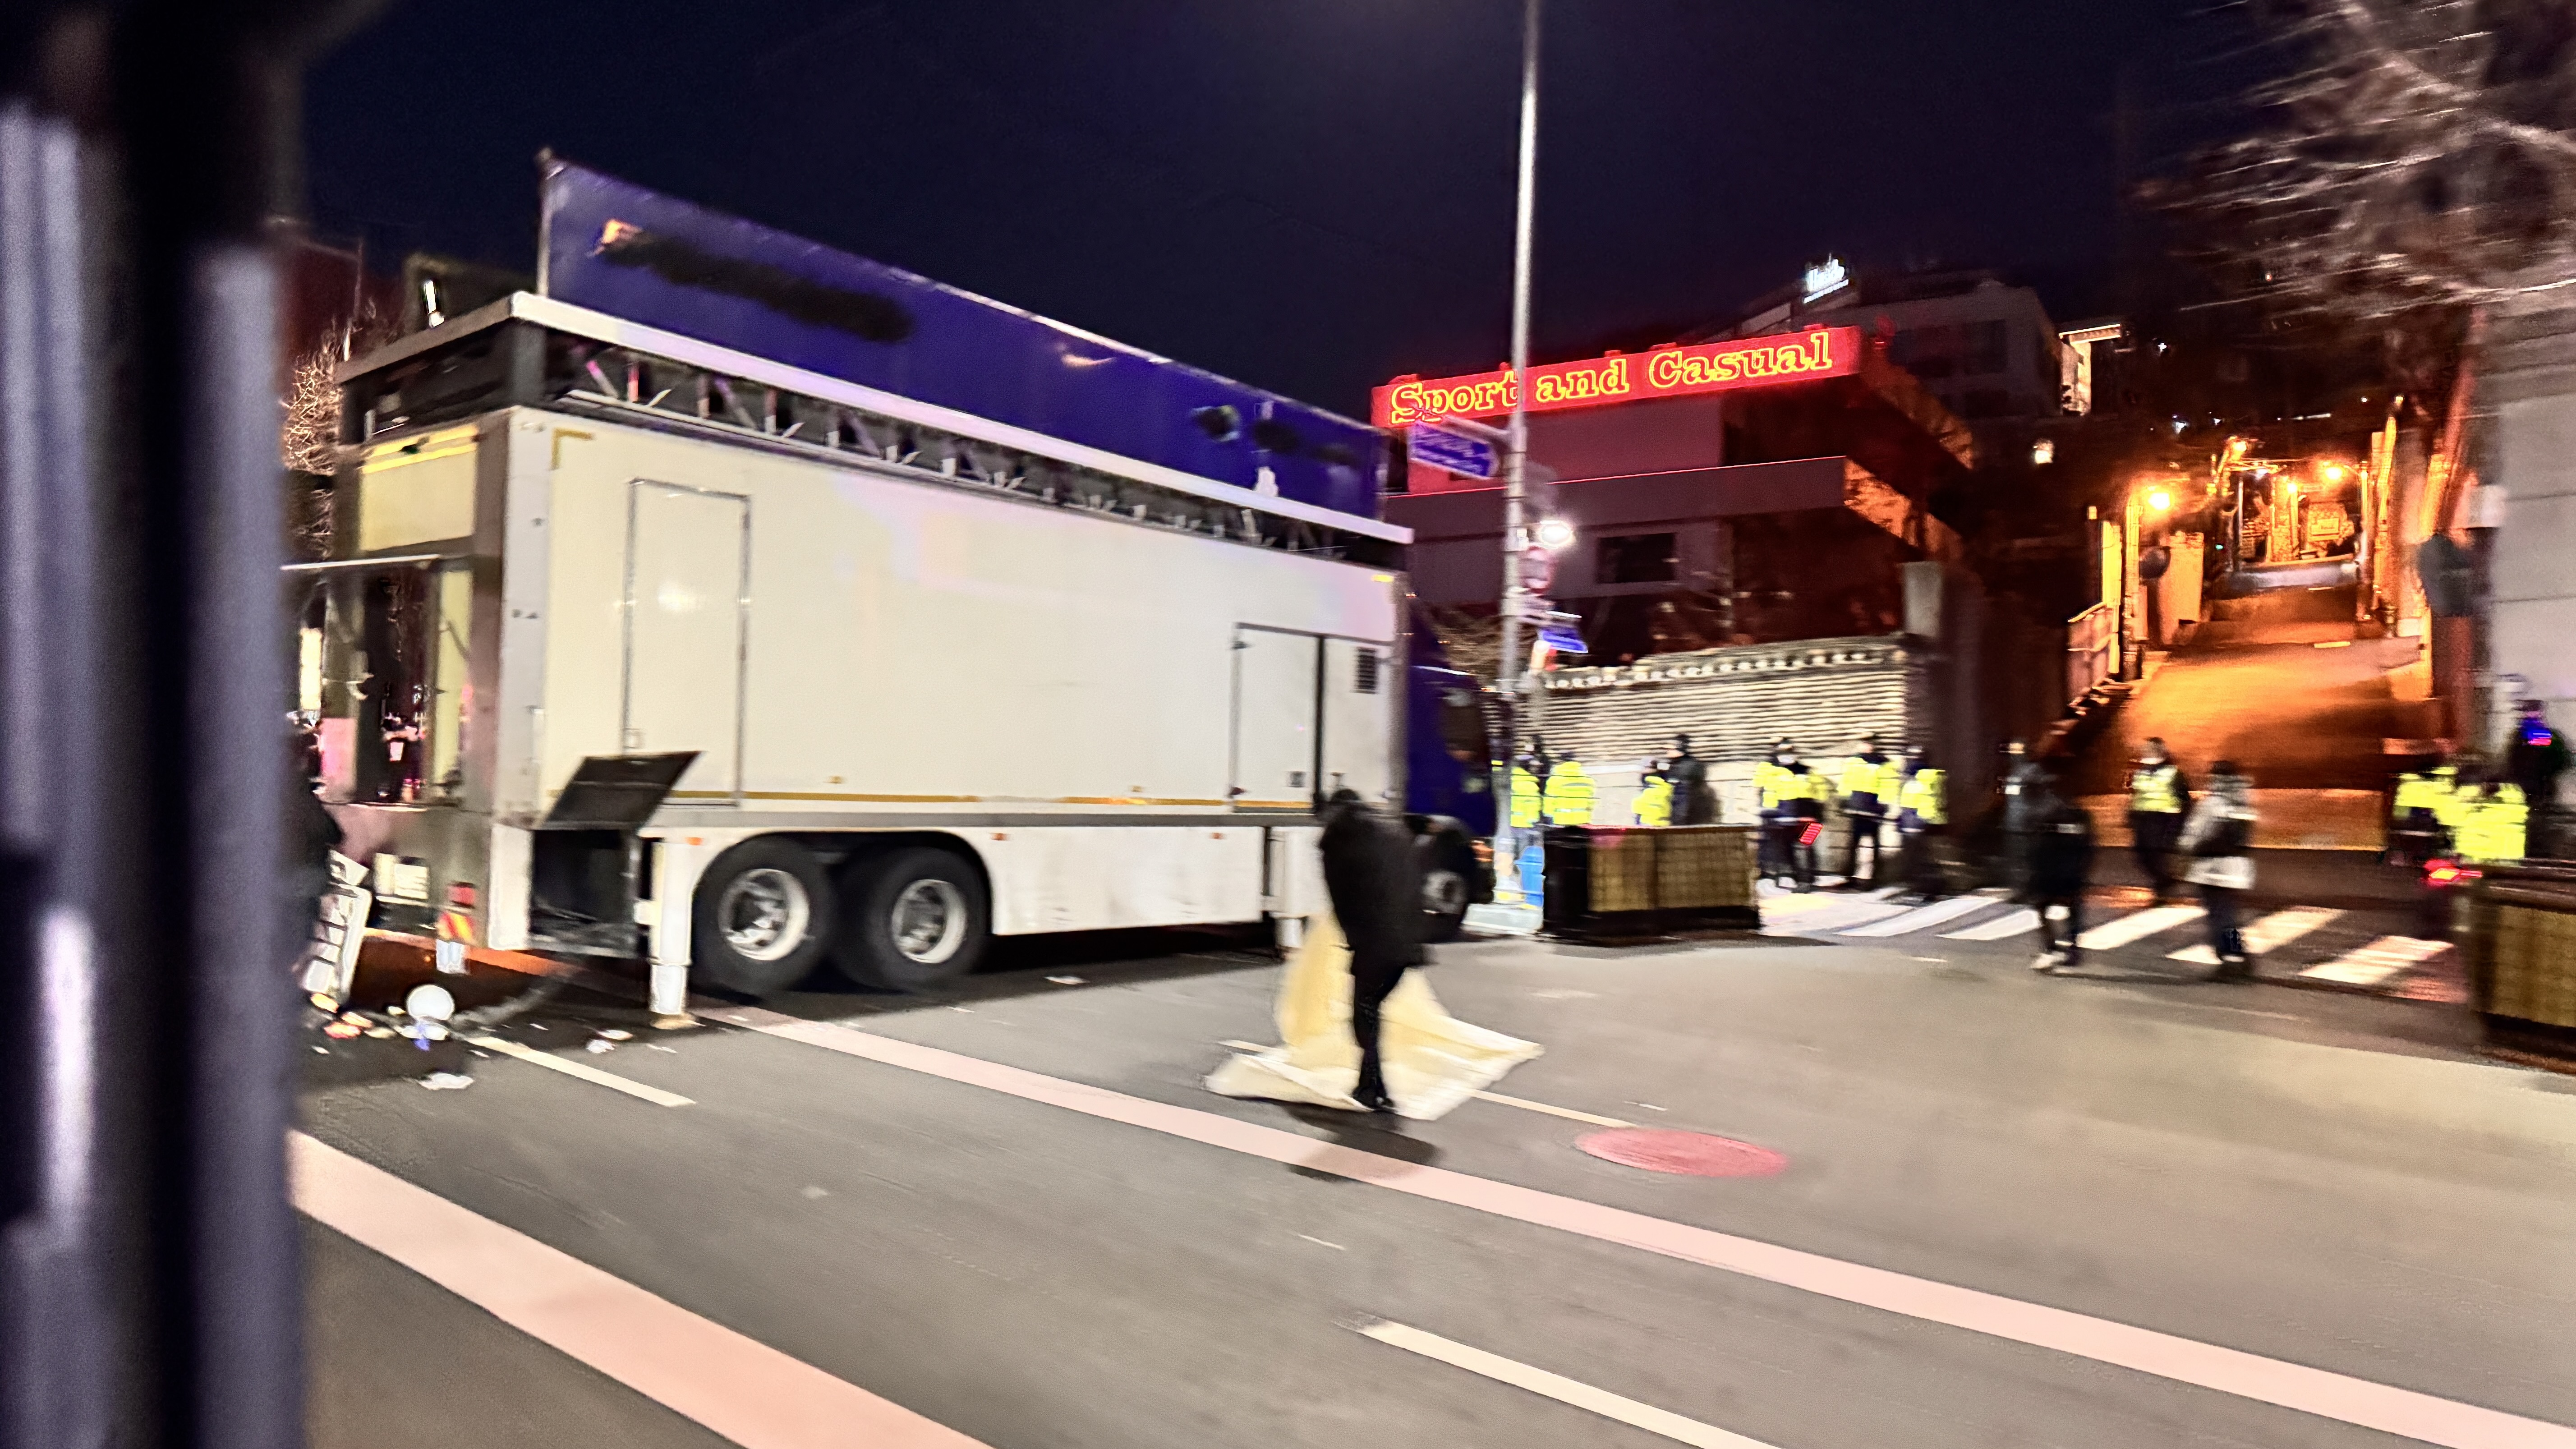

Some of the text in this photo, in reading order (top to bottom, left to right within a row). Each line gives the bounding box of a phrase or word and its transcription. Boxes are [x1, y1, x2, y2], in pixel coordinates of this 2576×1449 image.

[1391, 331, 1832, 423] Sport and Casual
